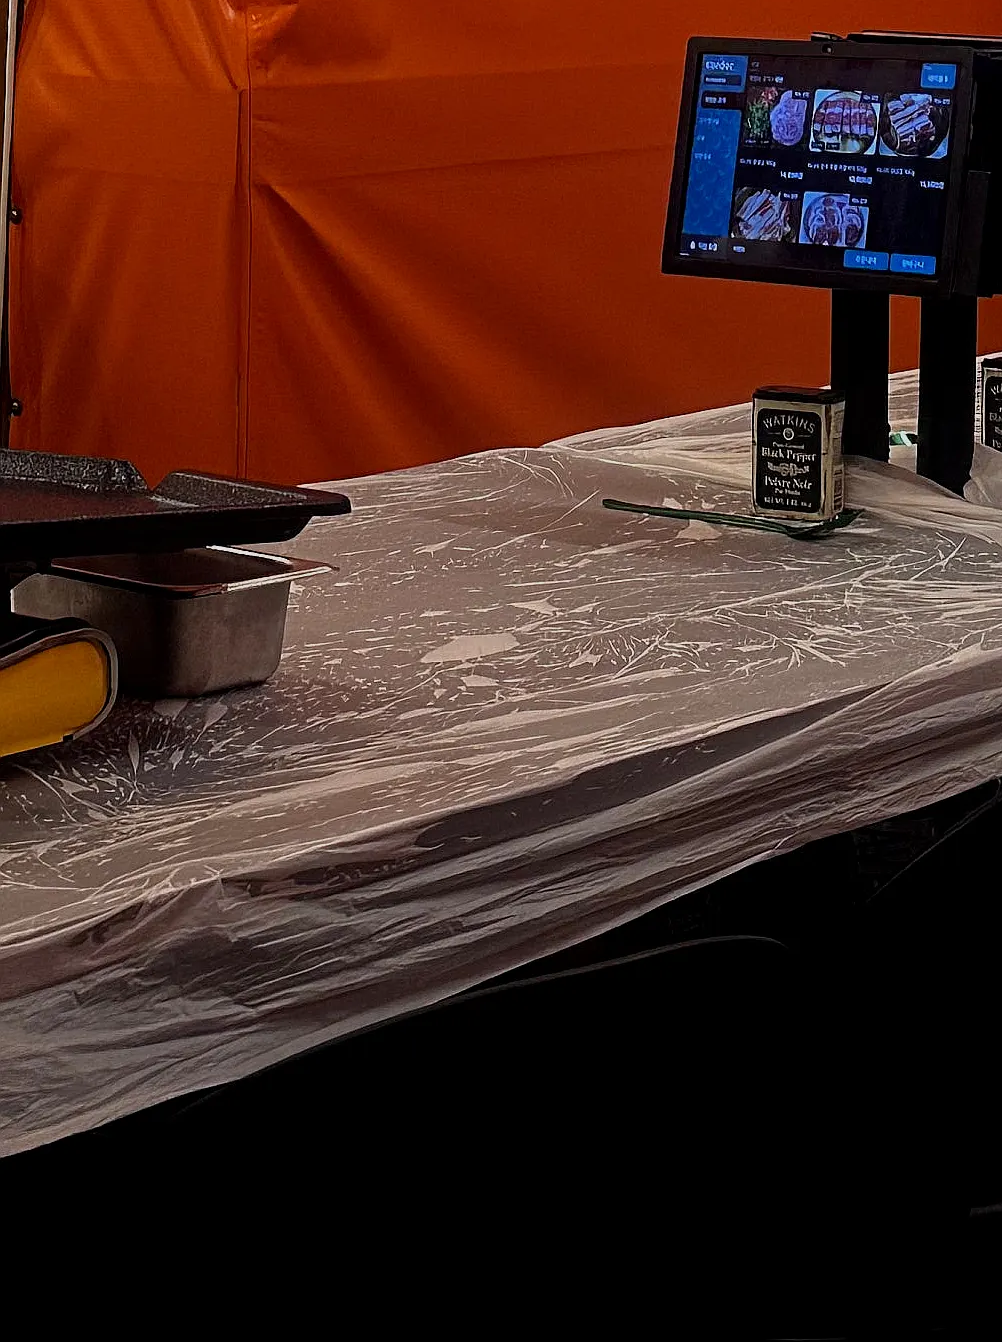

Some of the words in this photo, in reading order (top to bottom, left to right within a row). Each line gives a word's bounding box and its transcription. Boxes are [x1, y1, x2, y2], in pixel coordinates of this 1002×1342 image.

[763, 414, 816, 434] WATKINS
[761, 446, 785, 459] Black
[786, 449, 817, 463] Pepper
